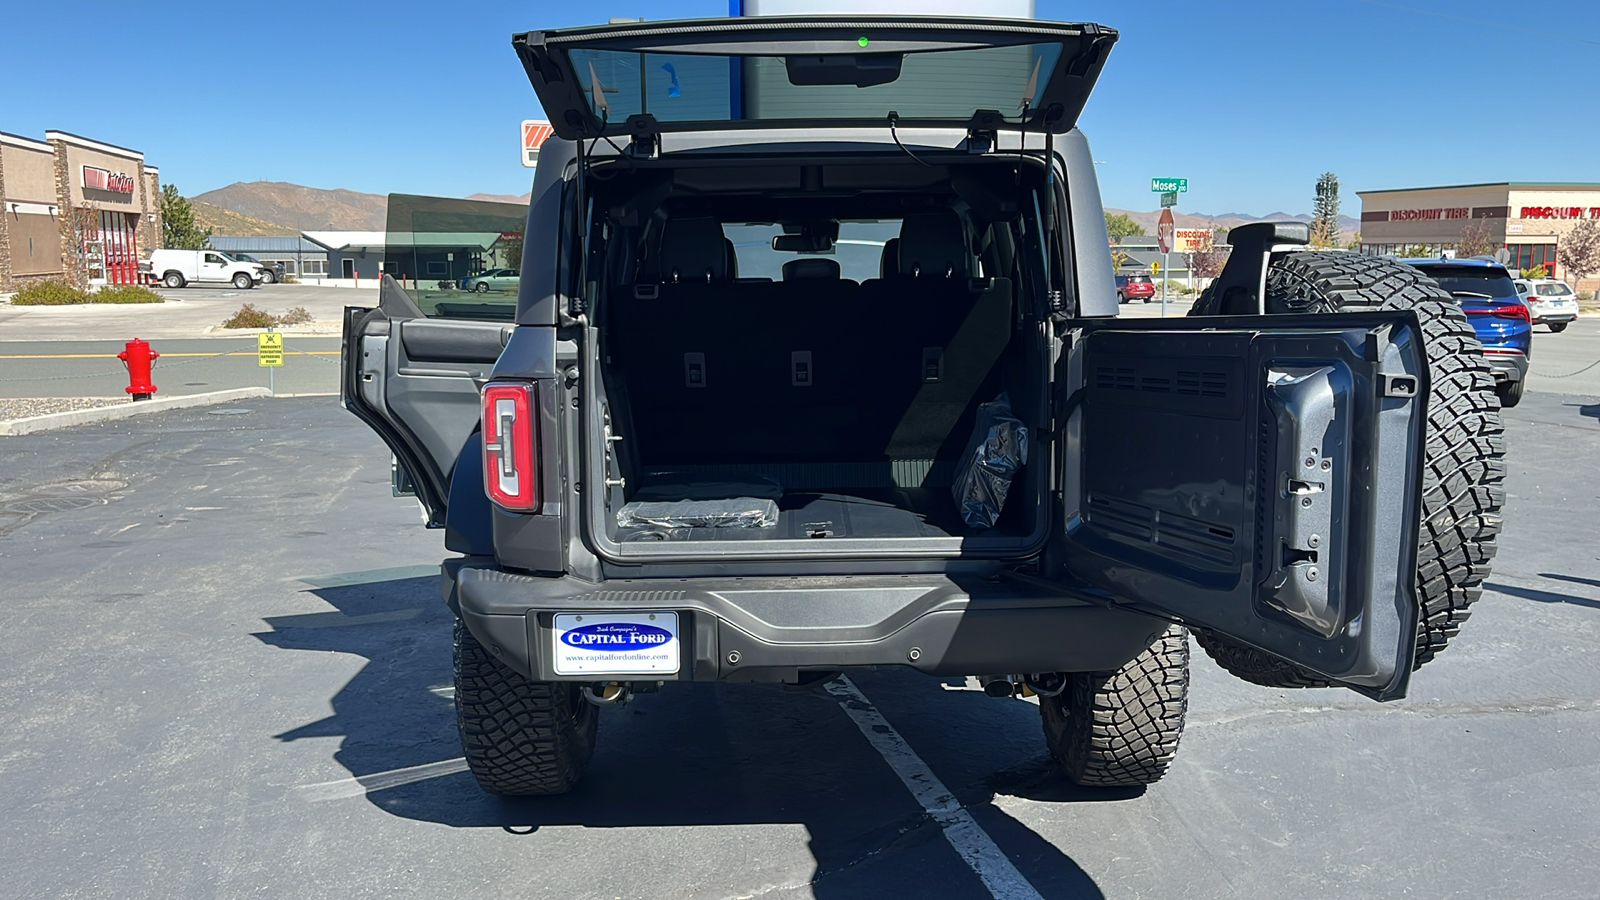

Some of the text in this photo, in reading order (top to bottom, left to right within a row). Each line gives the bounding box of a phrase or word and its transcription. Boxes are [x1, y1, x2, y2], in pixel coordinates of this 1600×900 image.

[1153, 180, 1177, 191] Moses
[1391, 207, 1469, 221] DISCOUNT TIRE
[1520, 206, 1587, 219] DISCOUNT
[565, 654, 669, 662] www.capitalfordonline.com
